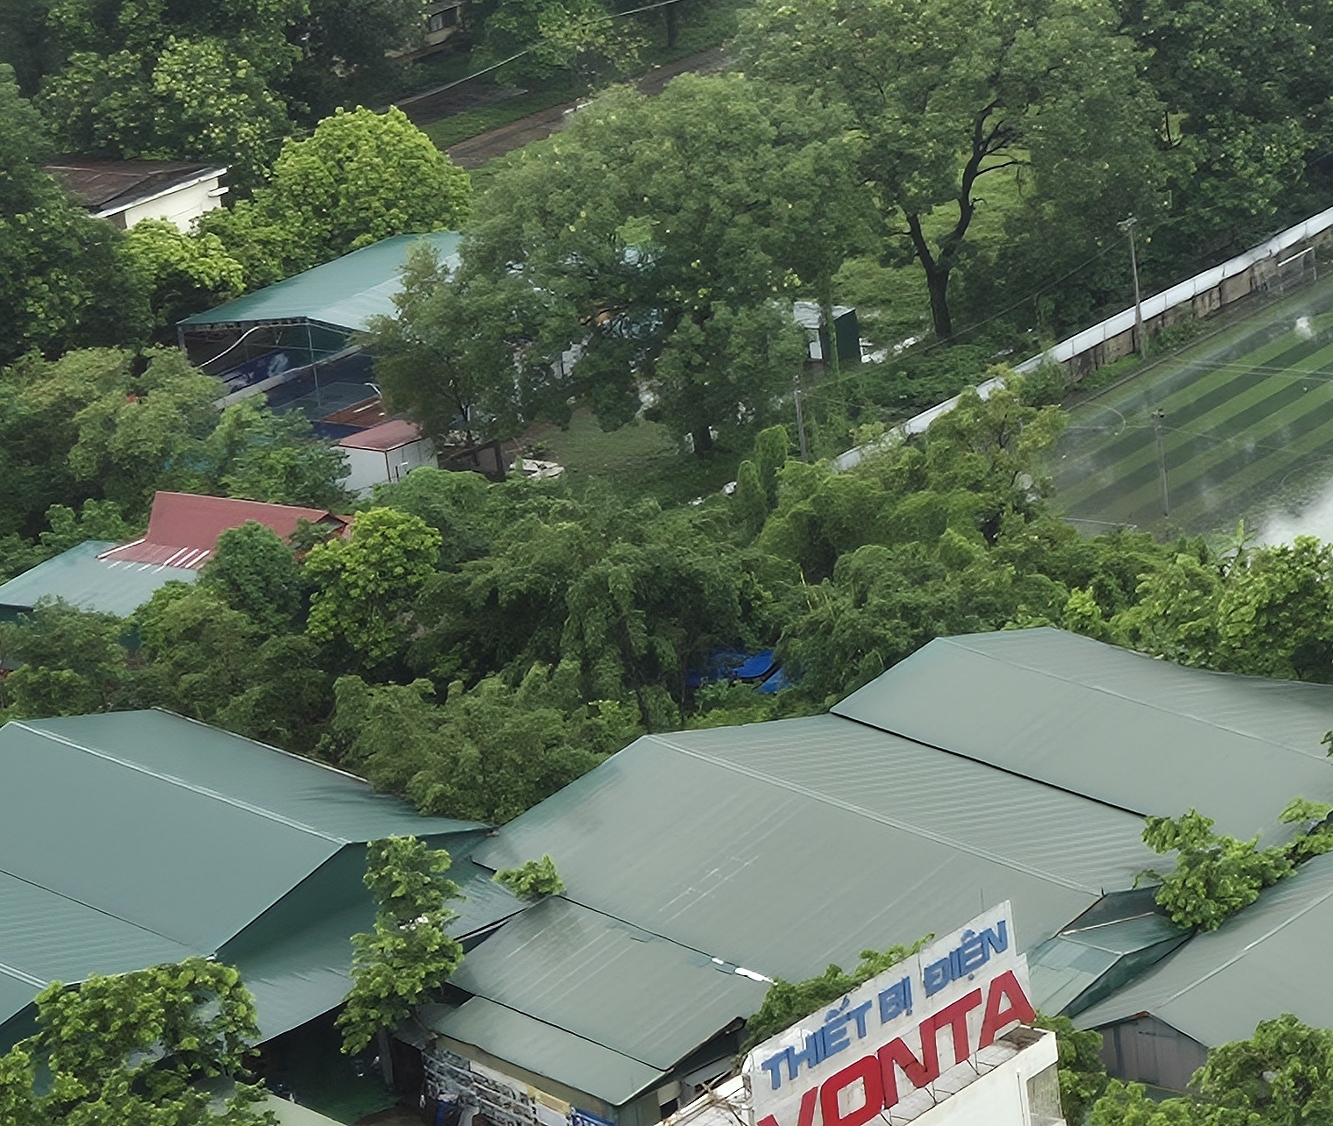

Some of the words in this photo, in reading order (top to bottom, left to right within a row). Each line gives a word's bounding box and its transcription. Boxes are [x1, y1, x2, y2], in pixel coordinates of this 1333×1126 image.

[761, 995, 872, 1090] THIẾT
[877, 976, 913, 1024] BỊ
[923, 920, 1008, 998] ĐIỆN
